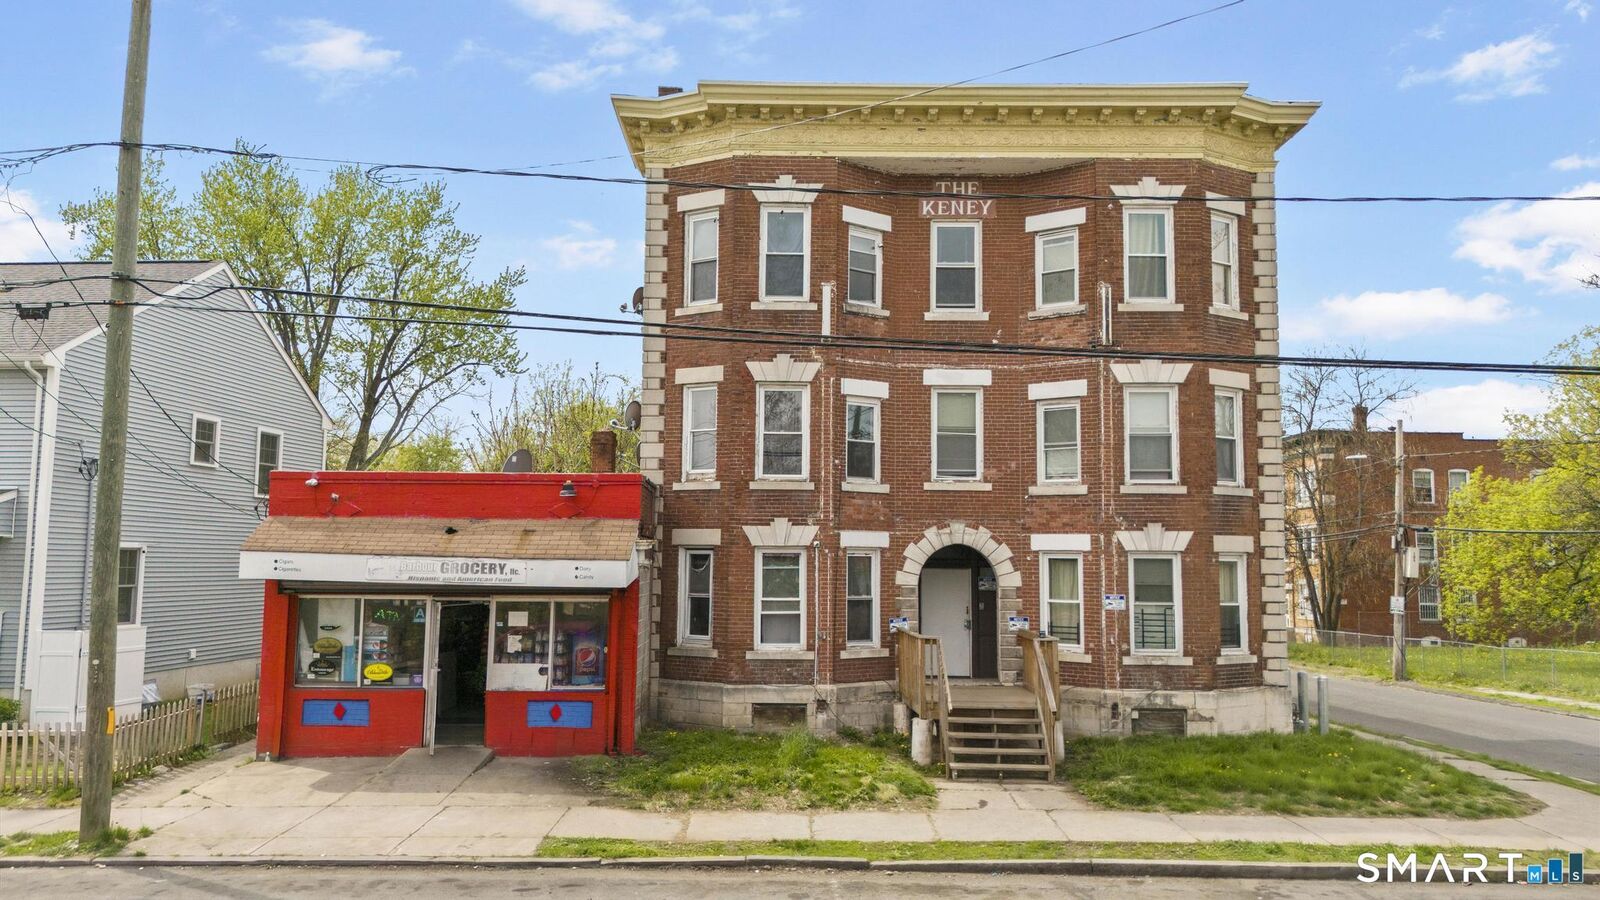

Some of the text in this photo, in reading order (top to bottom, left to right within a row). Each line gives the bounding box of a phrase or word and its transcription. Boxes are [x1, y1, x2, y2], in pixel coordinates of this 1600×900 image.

[935, 181, 980, 195] THE
[922, 200, 993, 215] KENEY
[440, 562, 508, 576] GROCERY,
[416, 608, 425, 618] A
